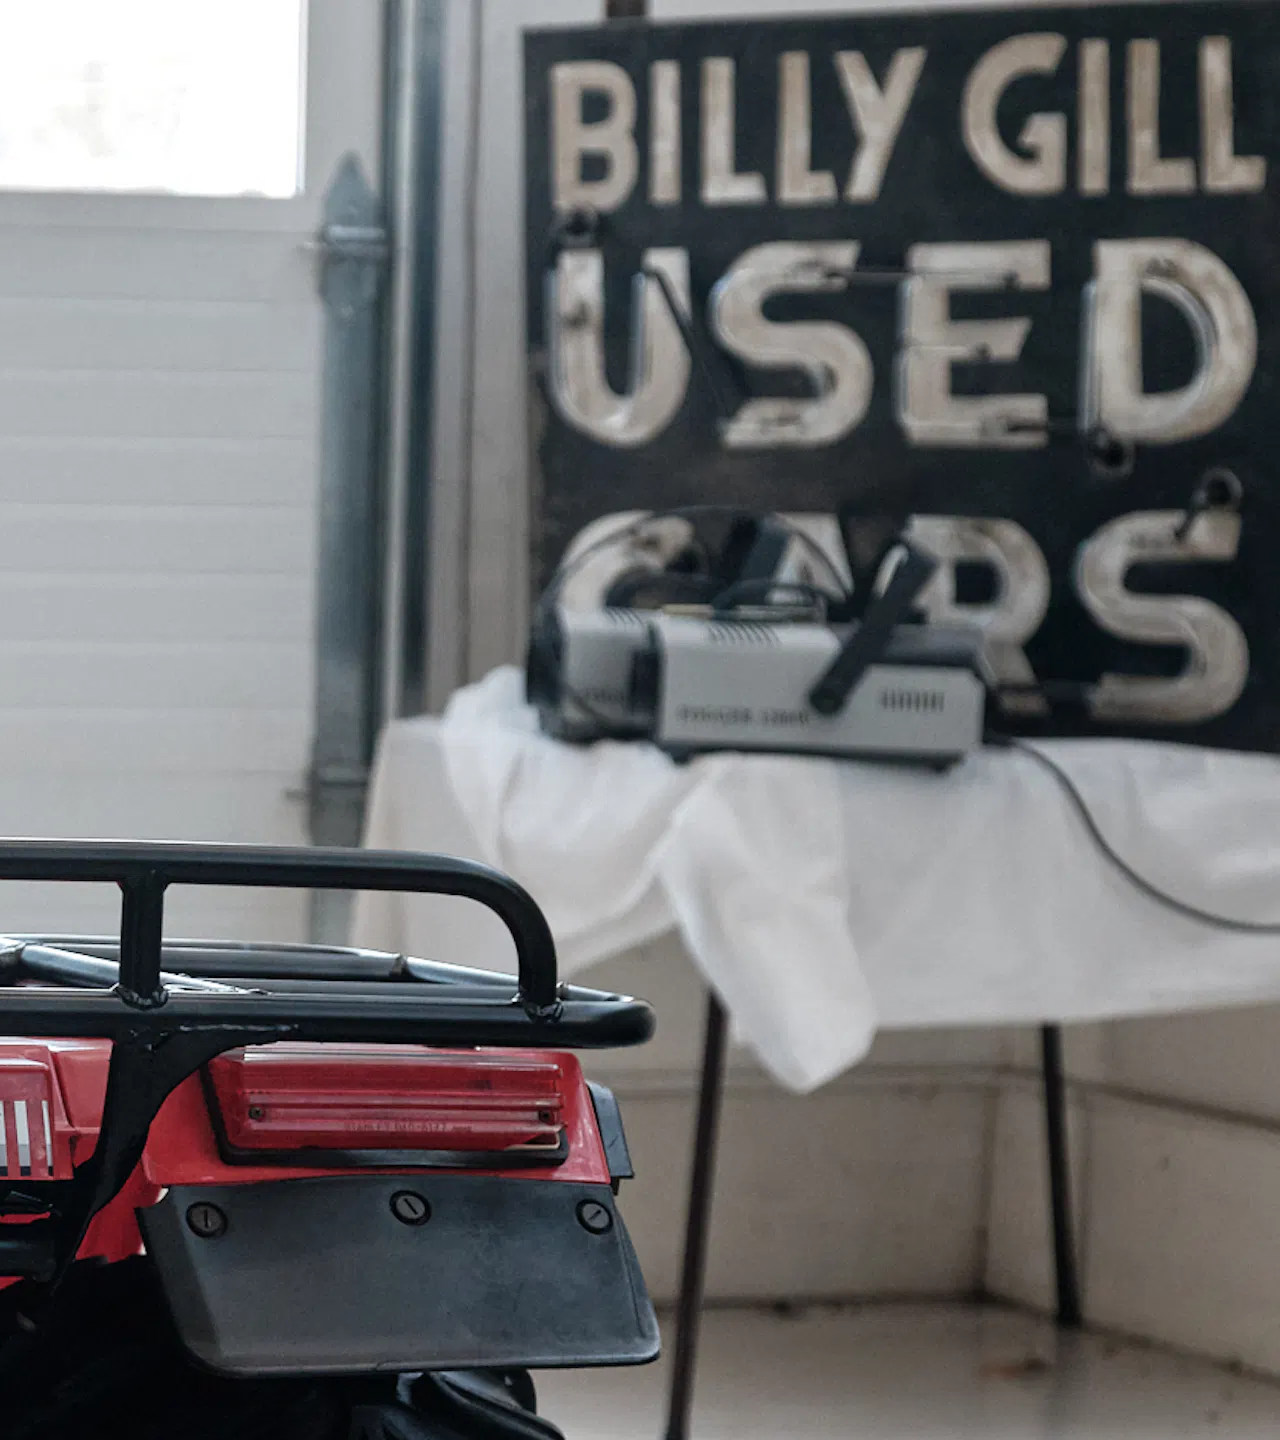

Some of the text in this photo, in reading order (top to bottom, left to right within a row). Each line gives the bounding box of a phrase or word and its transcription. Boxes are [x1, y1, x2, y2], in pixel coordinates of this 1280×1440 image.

[550, 31, 1266, 210] BILLY GILL
[549, 237, 1258, 450] USED
